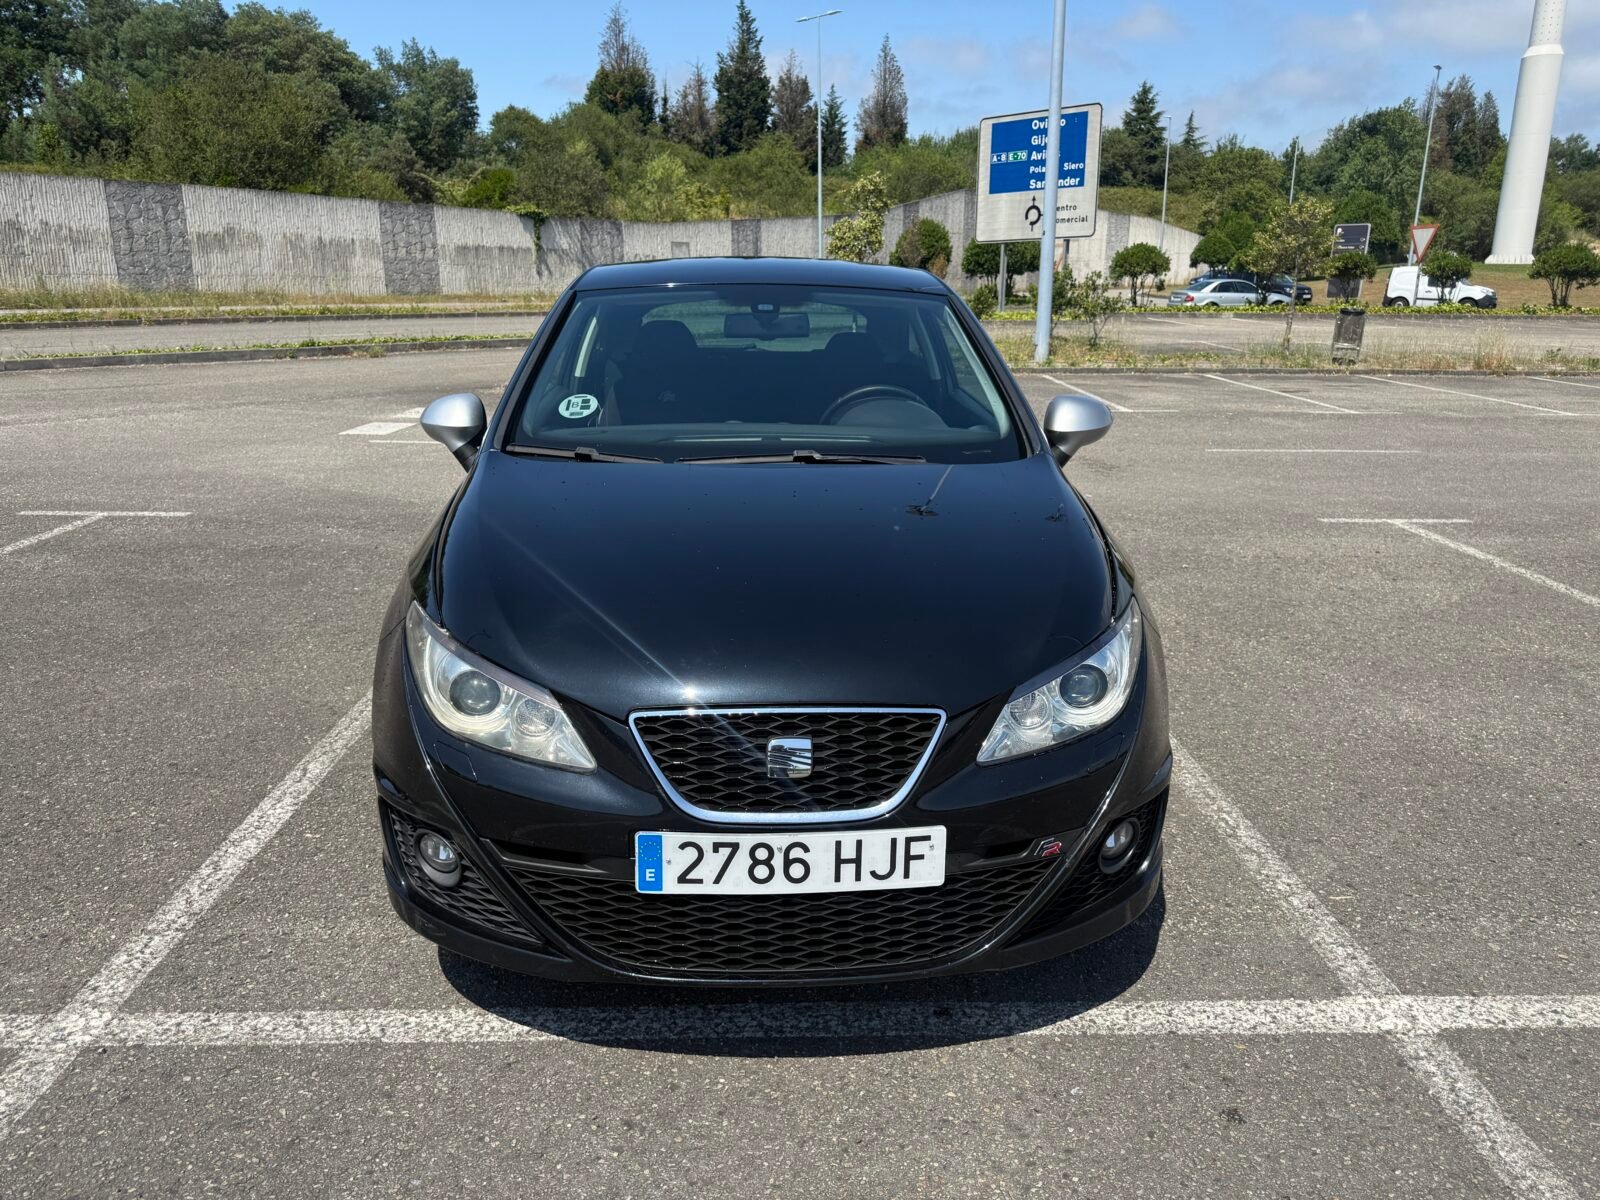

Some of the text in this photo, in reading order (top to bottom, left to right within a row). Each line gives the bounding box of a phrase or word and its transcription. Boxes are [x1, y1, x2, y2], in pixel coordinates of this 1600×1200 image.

[1031, 119, 1066, 130] Ovio
[1031, 134, 1048, 146] Gij
[1009, 152, 1026, 161] E-70
[1029, 162, 1084, 174] Pola Siero
[1029, 176, 1080, 189] Sannder
[1055, 215, 1088, 223] omercial
[645, 834, 932, 885] E 2786 HJF
